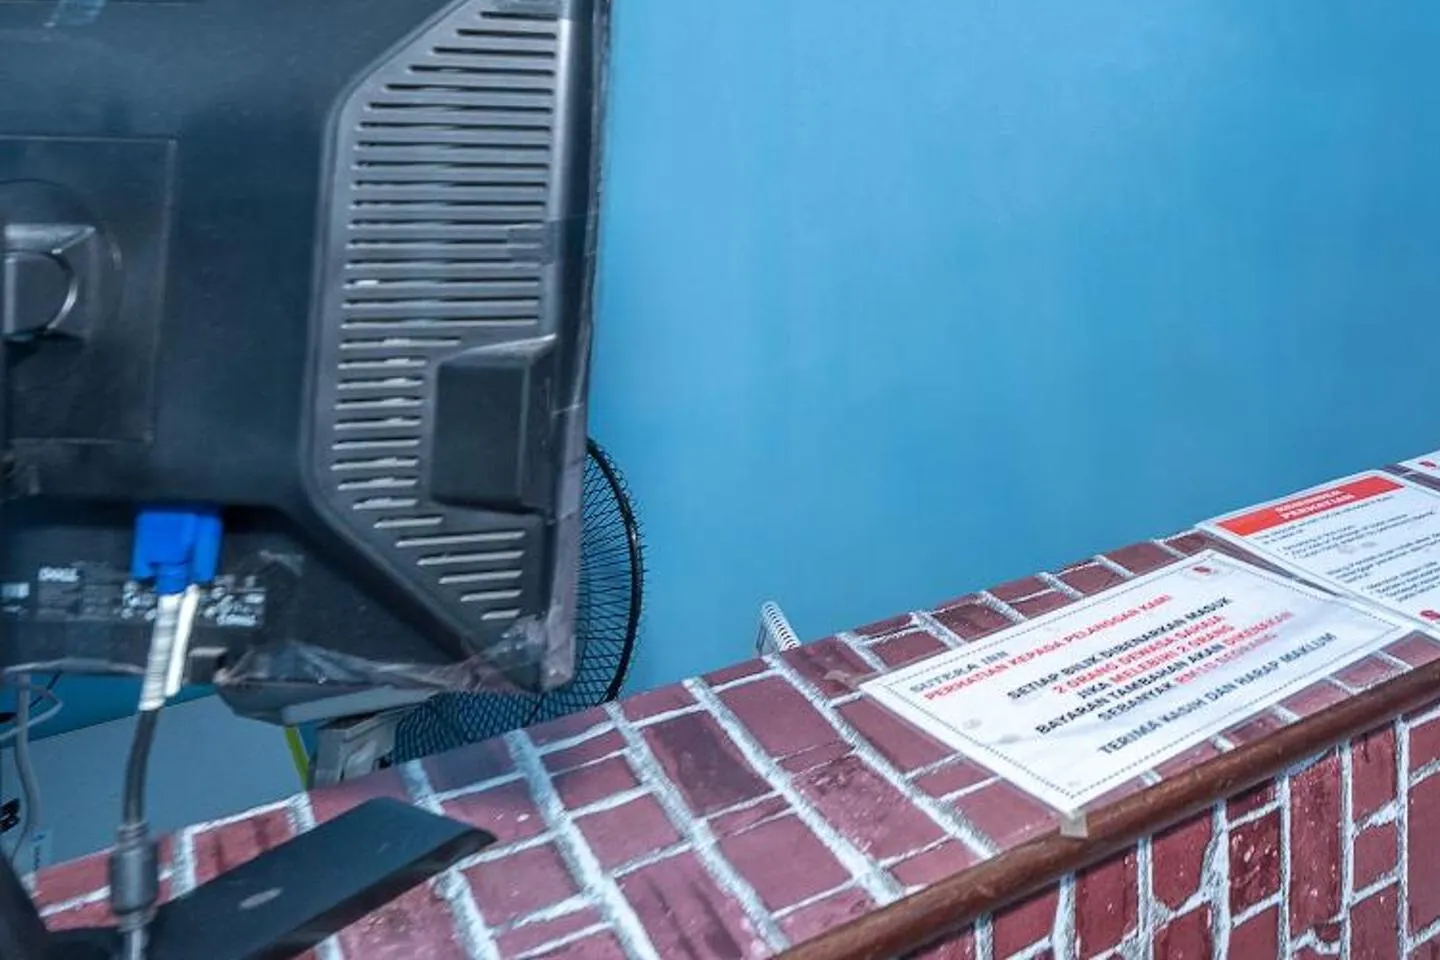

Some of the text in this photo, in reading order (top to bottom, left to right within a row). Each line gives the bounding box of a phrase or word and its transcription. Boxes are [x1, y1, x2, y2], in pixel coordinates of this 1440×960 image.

[1003, 671, 1063, 700] SETIAP
[1181, 596, 1236, 621] MASUK
[1005, 639, 1065, 666] KEPADA
[1032, 695, 1111, 734] BAYARAN
[1105, 659, 1190, 700] TAMBAHAN
[1182, 642, 1226, 663] AKAN
[1095, 631, 1340, 755] TERIMA KASIH DAN HARAP MAKLUM
[1094, 680, 1178, 722] SEBANYAK
